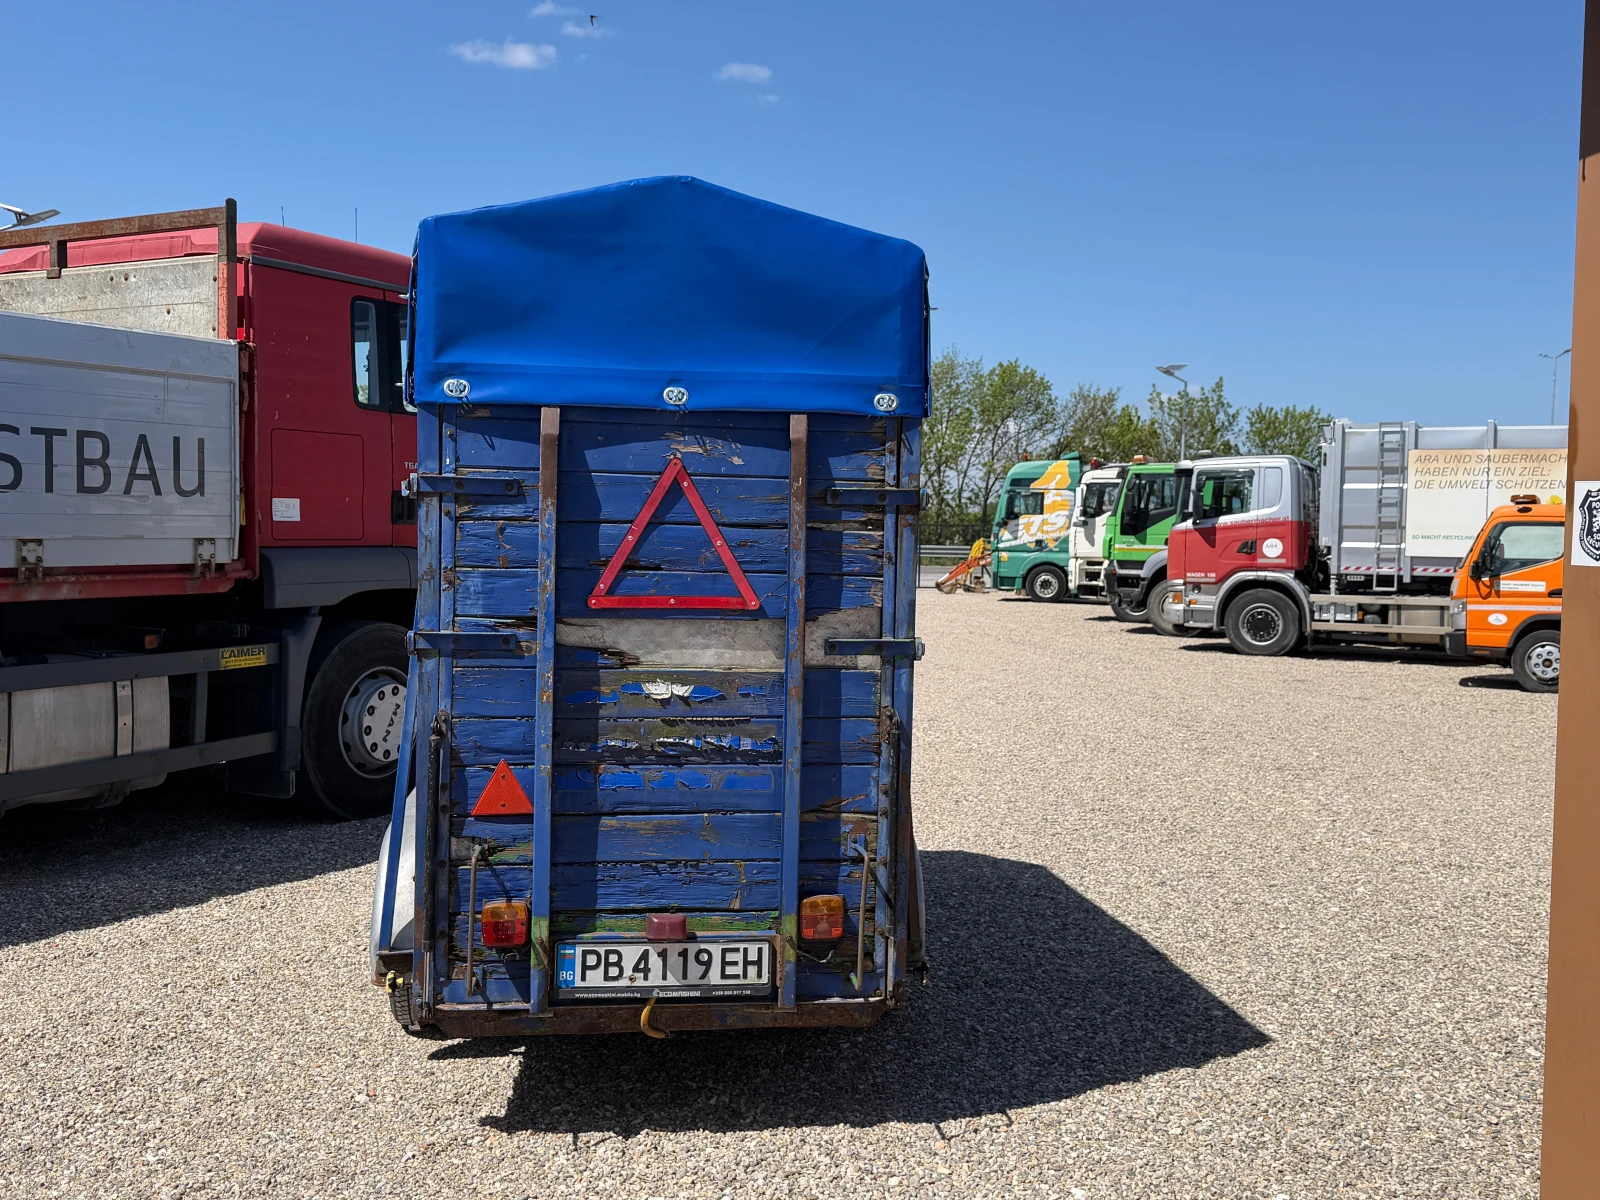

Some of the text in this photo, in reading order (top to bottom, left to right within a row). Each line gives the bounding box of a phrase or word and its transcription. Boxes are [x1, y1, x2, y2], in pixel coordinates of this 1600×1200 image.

[1414, 454, 1439, 464] ARA
[1443, 454, 1472, 464] UND
[1414, 466, 1551, 477] HABEN NUR EIN ZIEL:
[1414, 477, 1567, 490] DIE UMWELT SCHÜTZEN
[221, 646, 266, 660] LAIMER
[382, 702, 401, 743] MAN
[559, 970, 574, 981] BG
